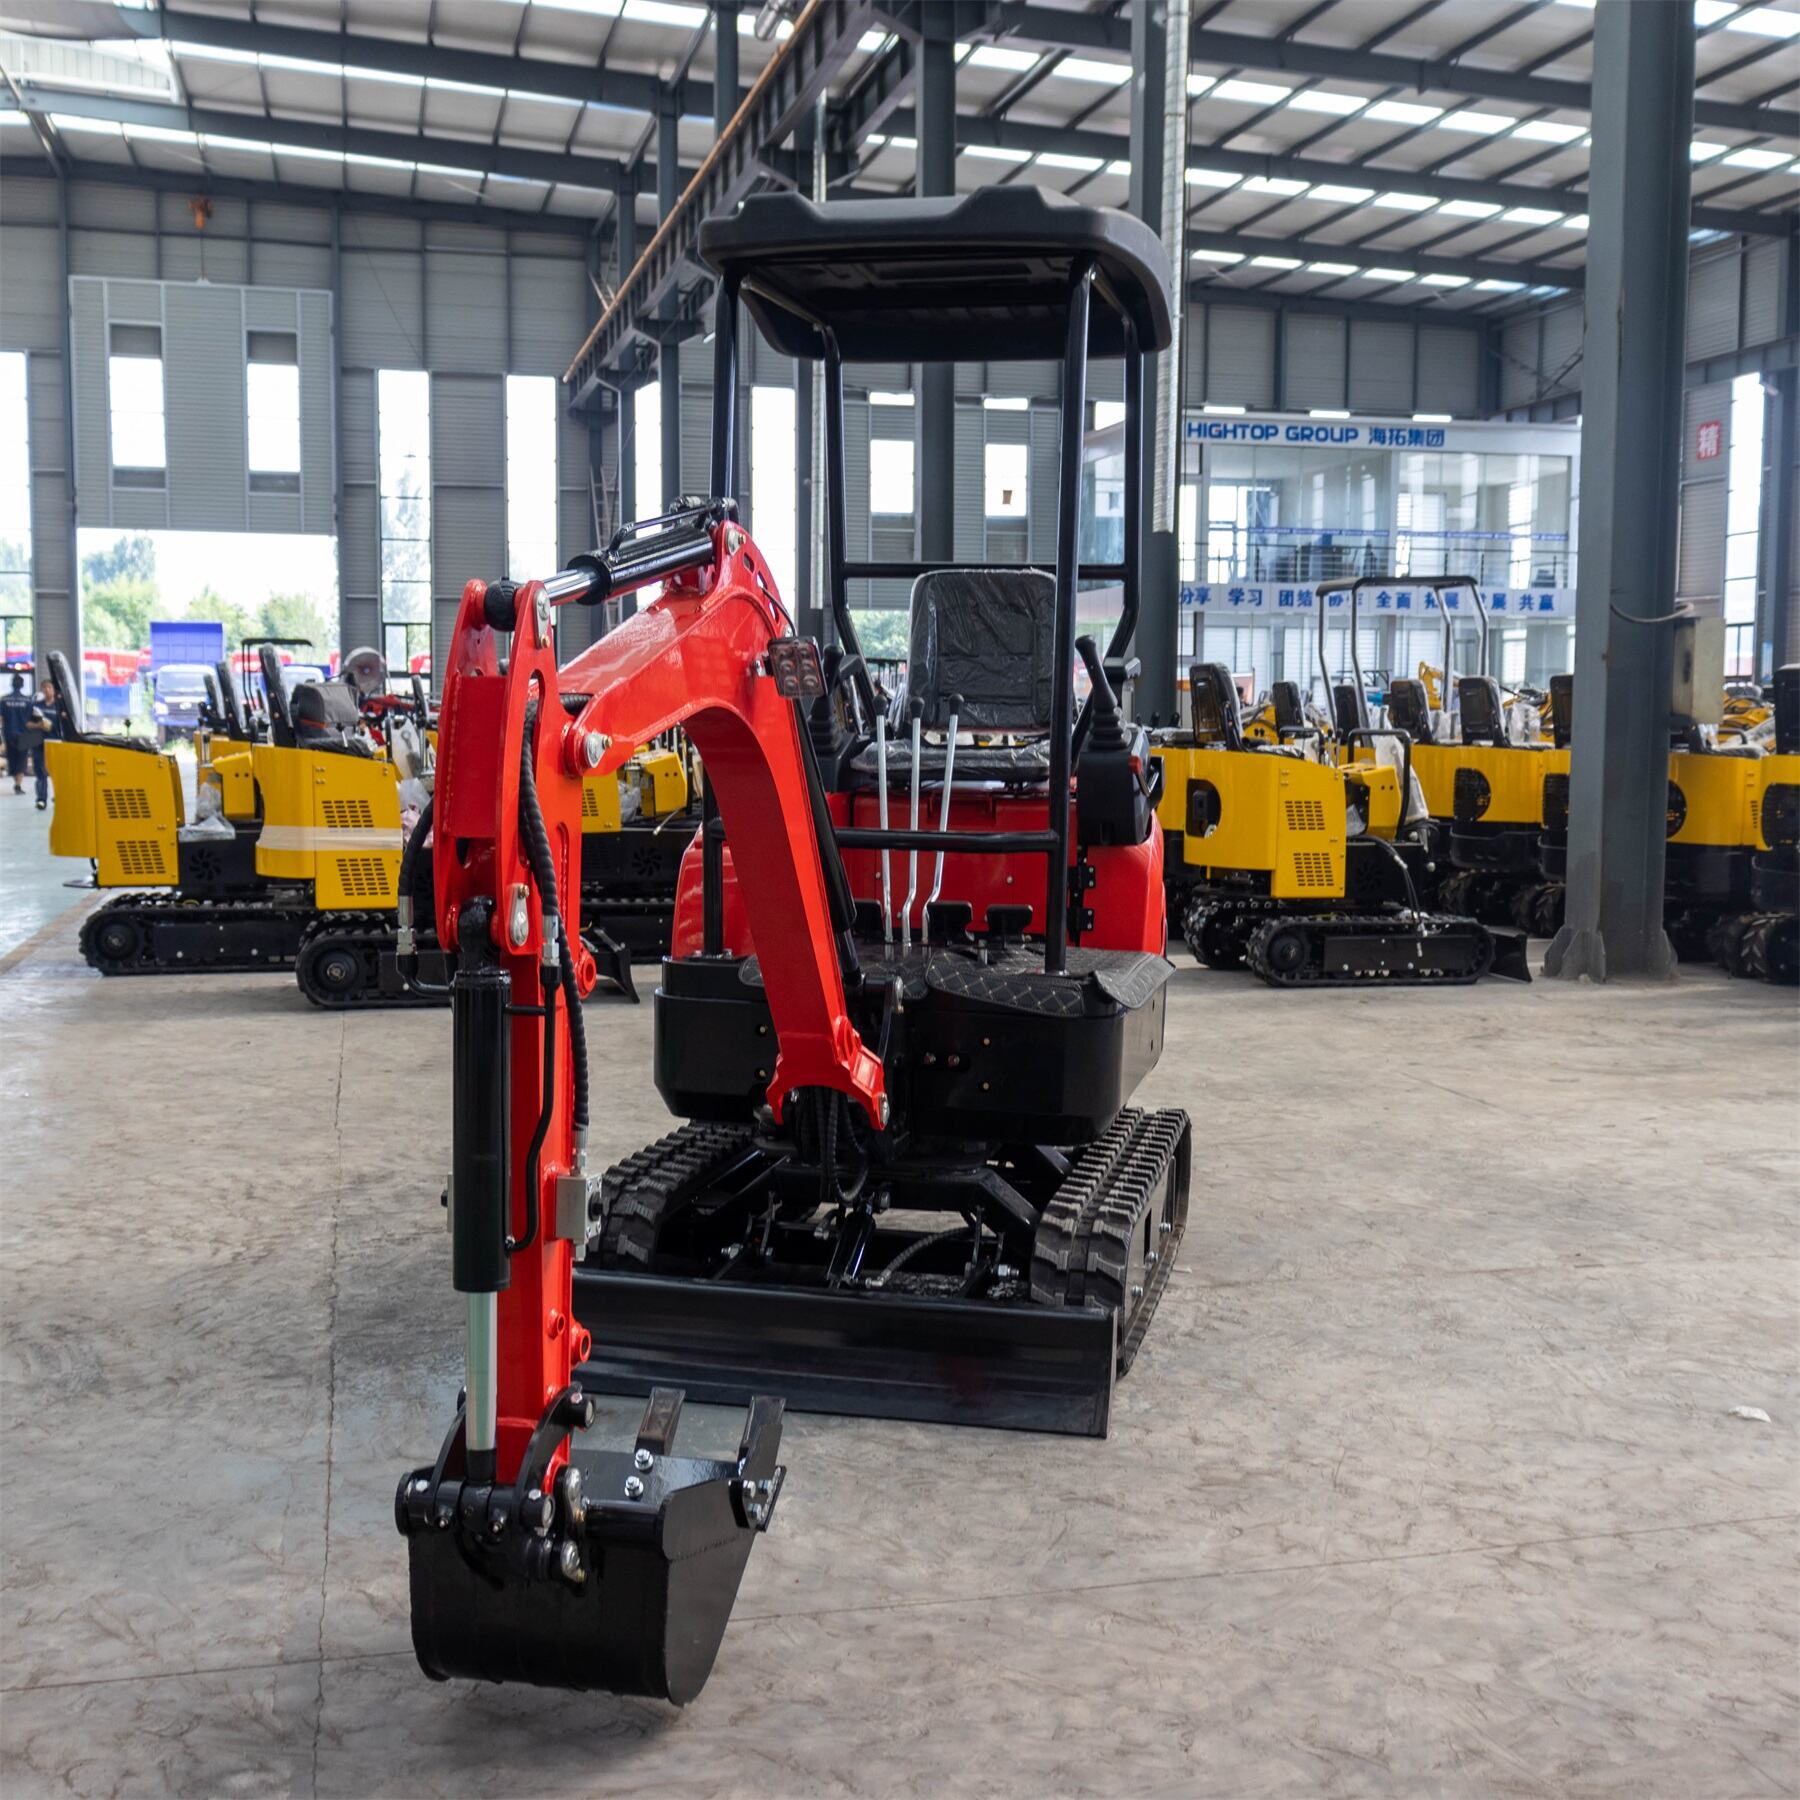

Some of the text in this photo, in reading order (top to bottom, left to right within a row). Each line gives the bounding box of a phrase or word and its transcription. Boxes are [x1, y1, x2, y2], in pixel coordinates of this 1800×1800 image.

[1187, 422, 1359, 443] HIGHTOP GROUP
[1368, 427, 1445, 447] 海拓集团
[1228, 587, 1263, 606] 学习
[1278, 589, 1313, 607] 团结
[1519, 593, 1555, 612] 共赢
